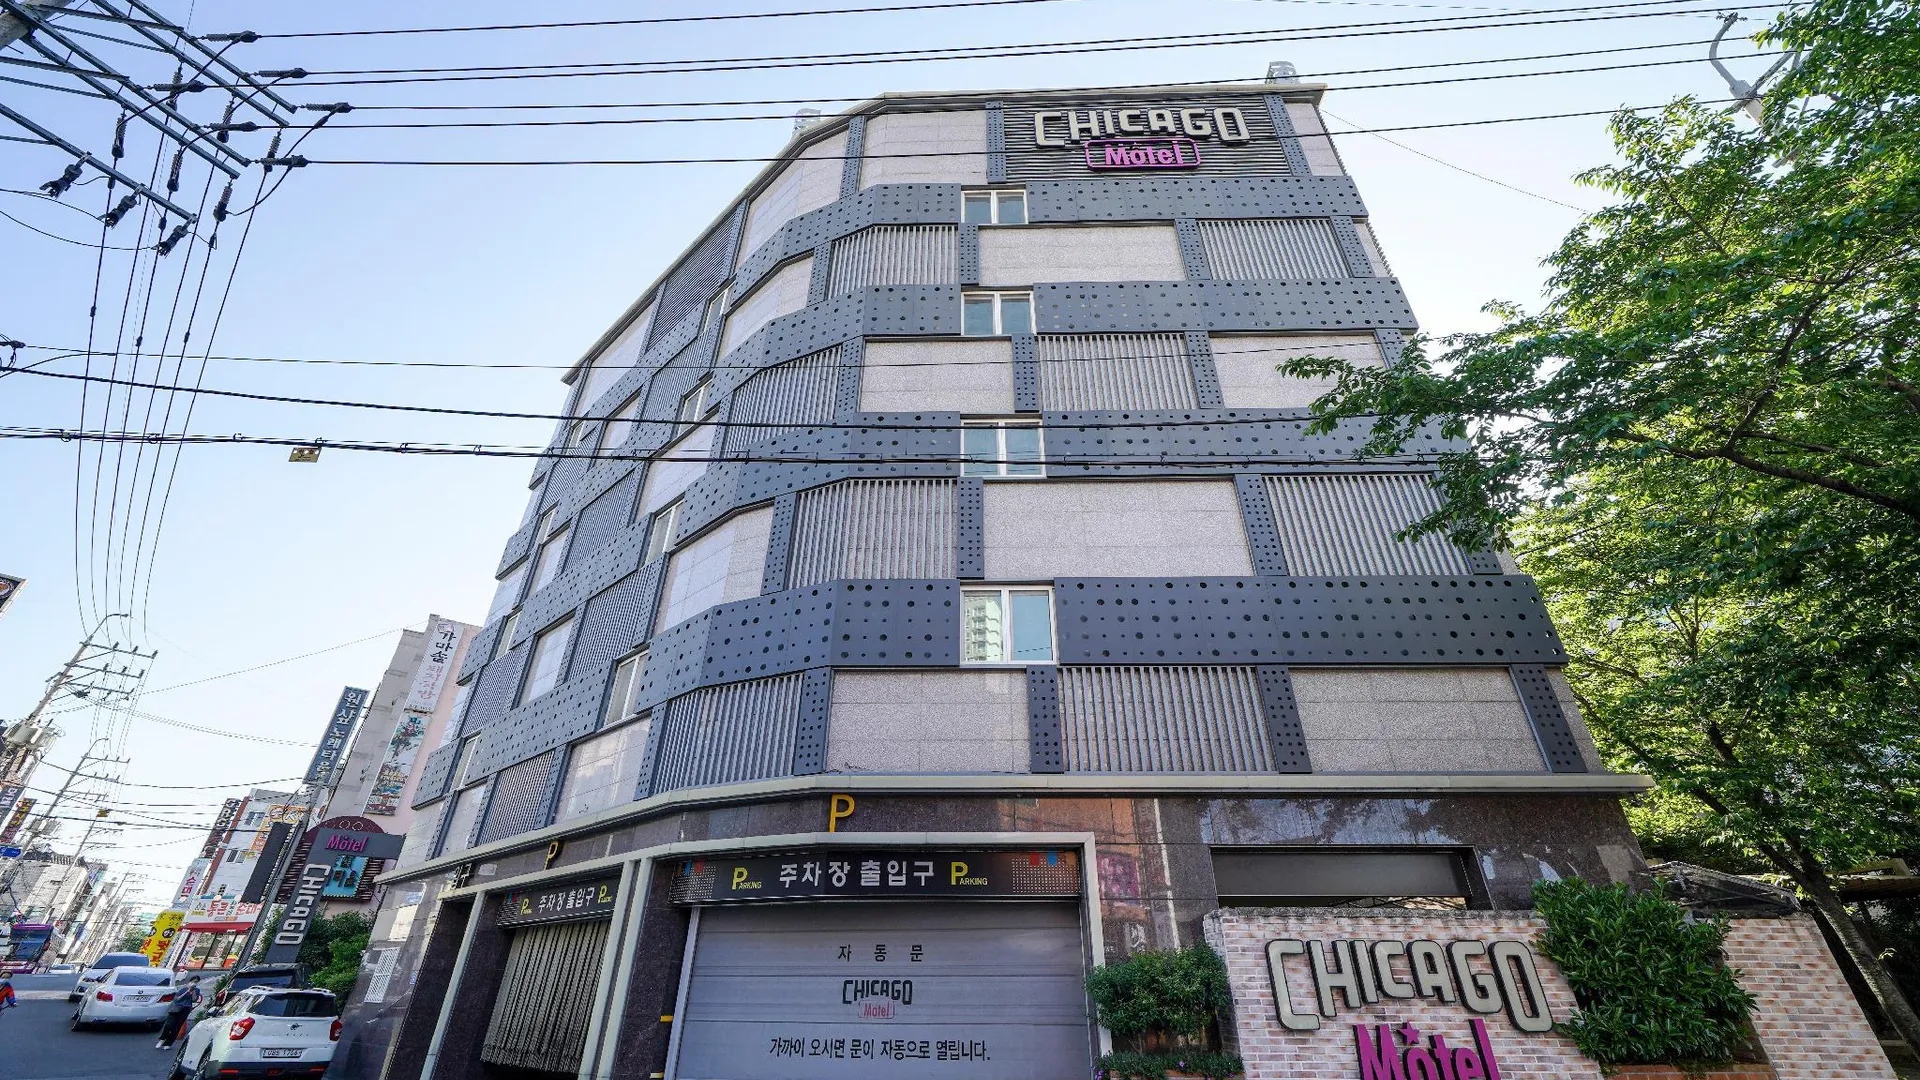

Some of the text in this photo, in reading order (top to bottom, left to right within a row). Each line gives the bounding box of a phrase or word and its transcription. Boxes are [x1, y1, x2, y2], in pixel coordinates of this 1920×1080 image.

[1034, 107, 1251, 148] CHICAGO
[1104, 141, 1184, 165] Motel
[829, 794, 855, 833] P
[326, 833, 370, 852] Motel
[543, 841, 559, 870] P
[780, 861, 851, 888] 주차장
[860, 859, 934, 887] 출입구
[950, 861, 988, 886] PARKING
[275, 863, 332, 945] CHICAGO
[538, 891, 566, 914] 주차장
[565, 887, 595, 909] 출입구
[842, 979, 913, 1006] CHICAGO
[1265, 939, 1553, 1032] CHICAGO
[863, 1002, 890, 1018] Motel
[769, 1037, 991, 1061] 가까이 오시면 문이 자동으로 열립니다.
[1353, 1018, 1501, 1080] Motel
